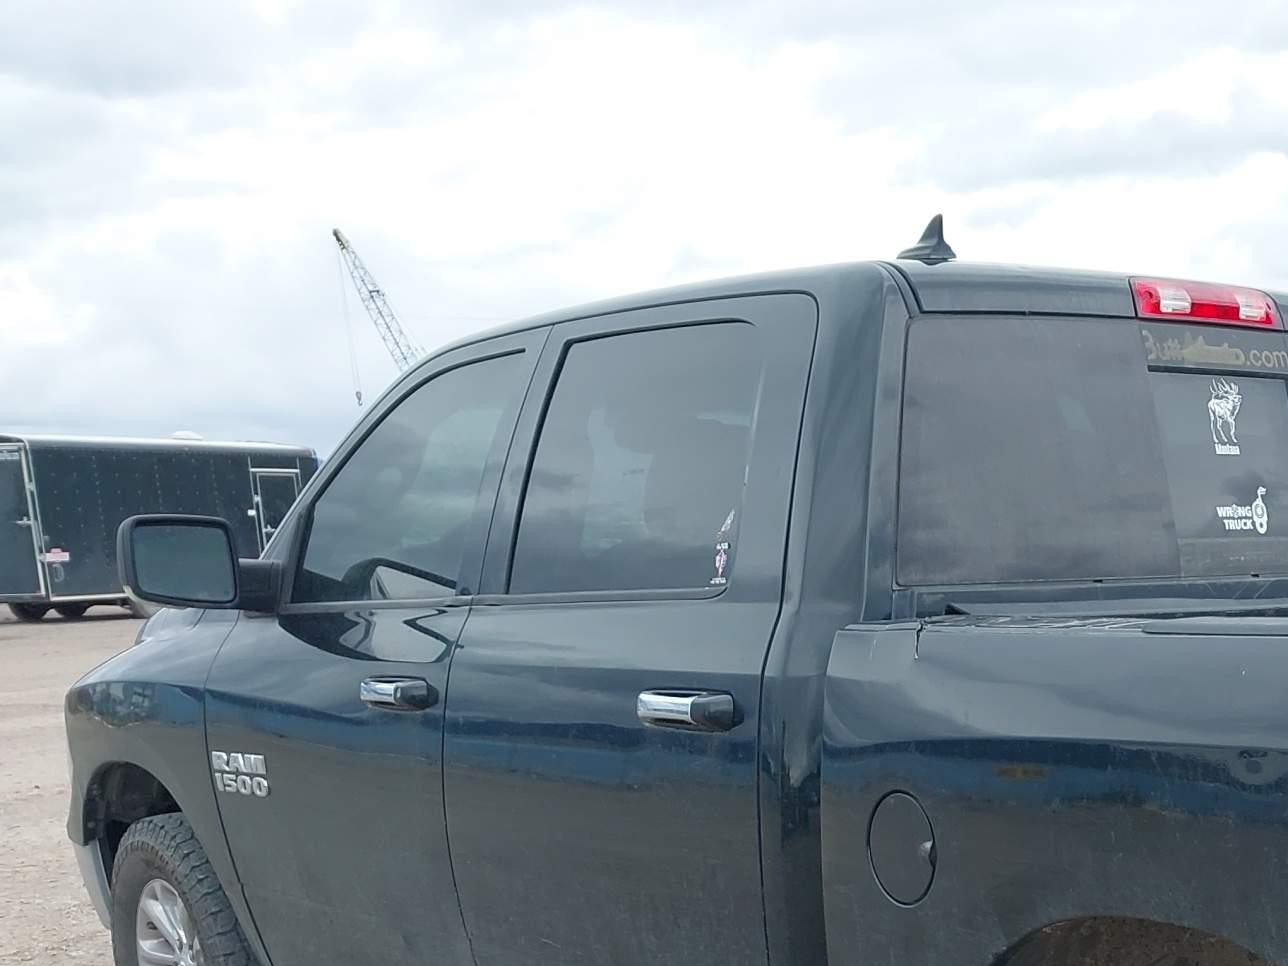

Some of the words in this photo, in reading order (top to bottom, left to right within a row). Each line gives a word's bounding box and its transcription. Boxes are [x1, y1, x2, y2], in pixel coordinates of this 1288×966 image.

[1223, 519, 1254, 530] TRUCK
[211, 751, 267, 774] RAM
[215, 772, 269, 797] 1500
